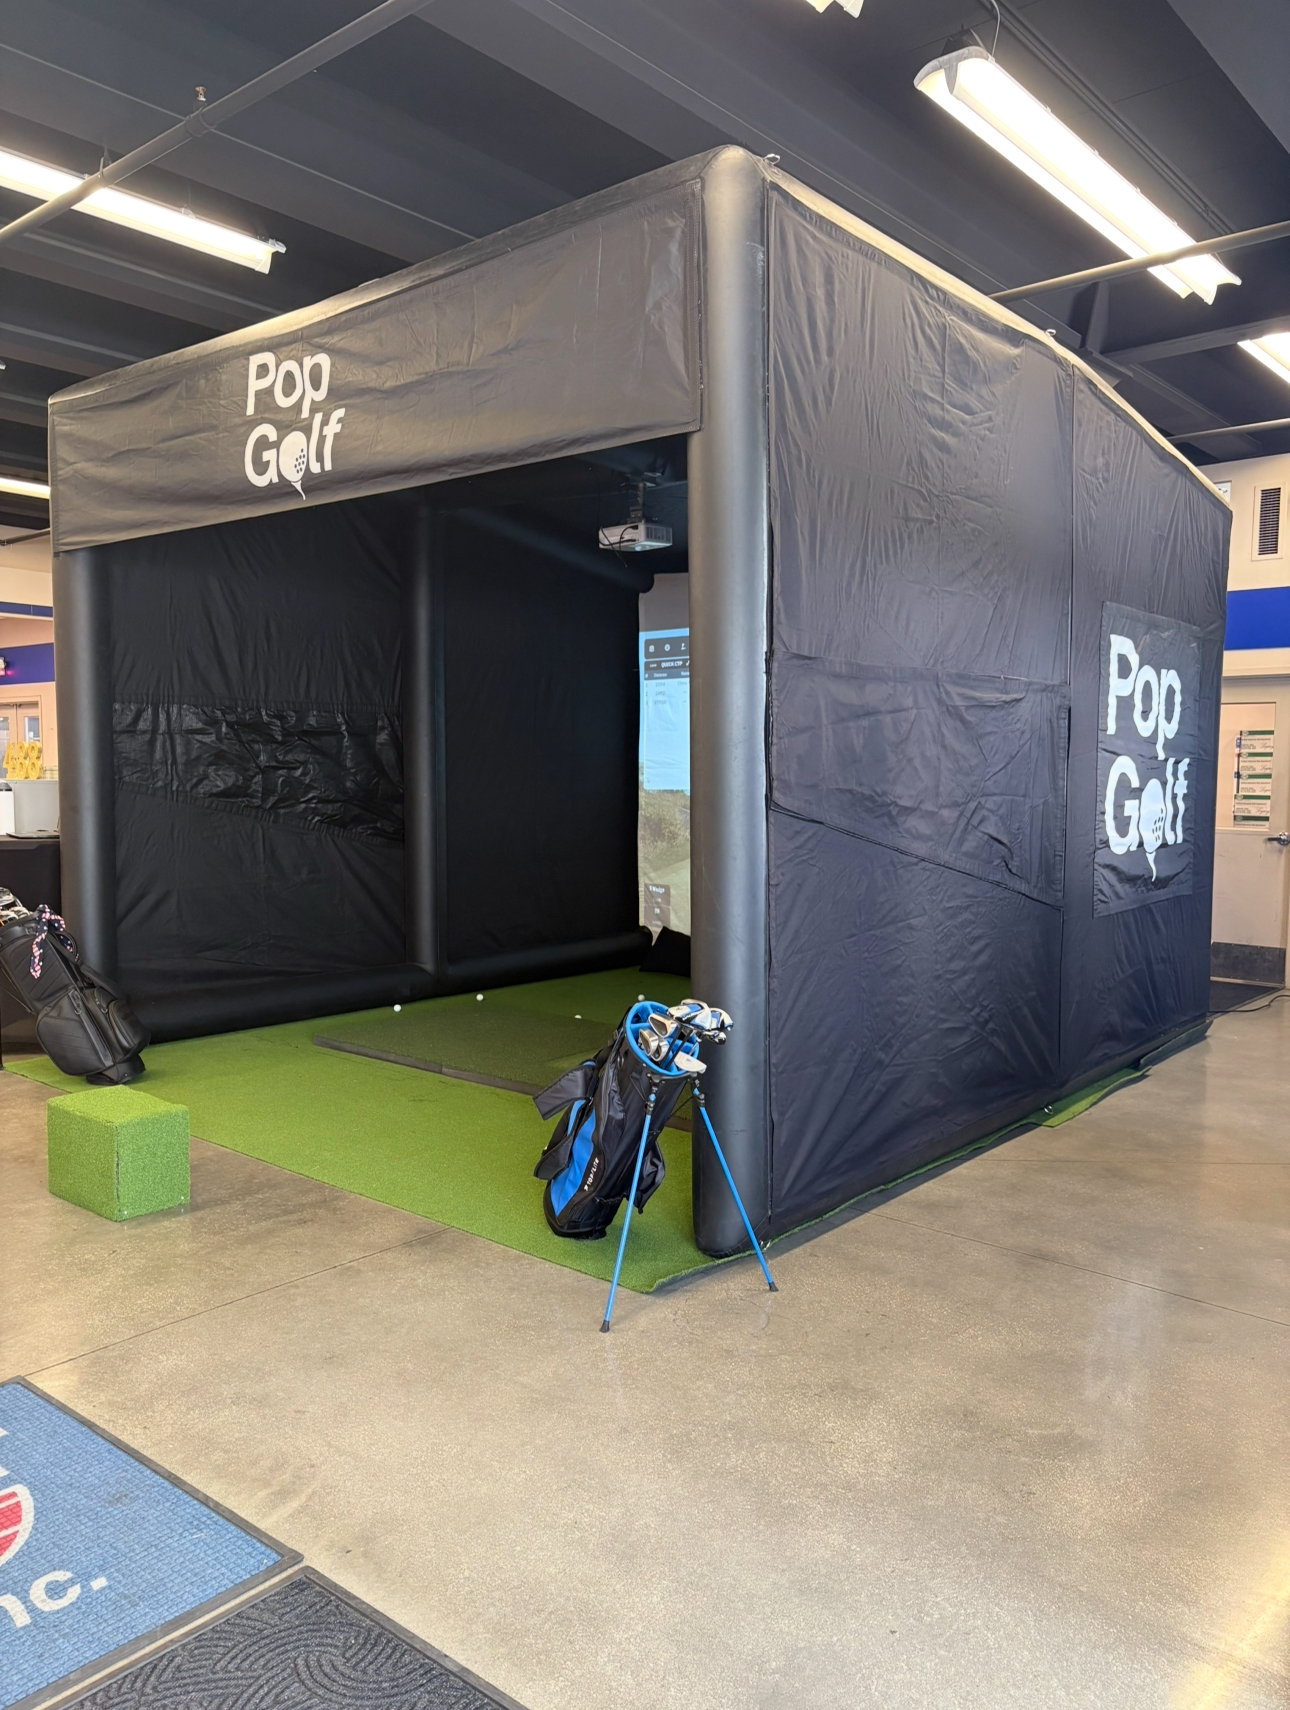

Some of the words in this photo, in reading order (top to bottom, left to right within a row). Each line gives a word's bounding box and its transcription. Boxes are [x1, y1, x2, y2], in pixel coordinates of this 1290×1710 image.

[246, 351, 331, 419] Pop
[244, 407, 346, 501] Golf
[1106, 633, 1182, 761] Pop
[1104, 755, 1190, 882] Golf
